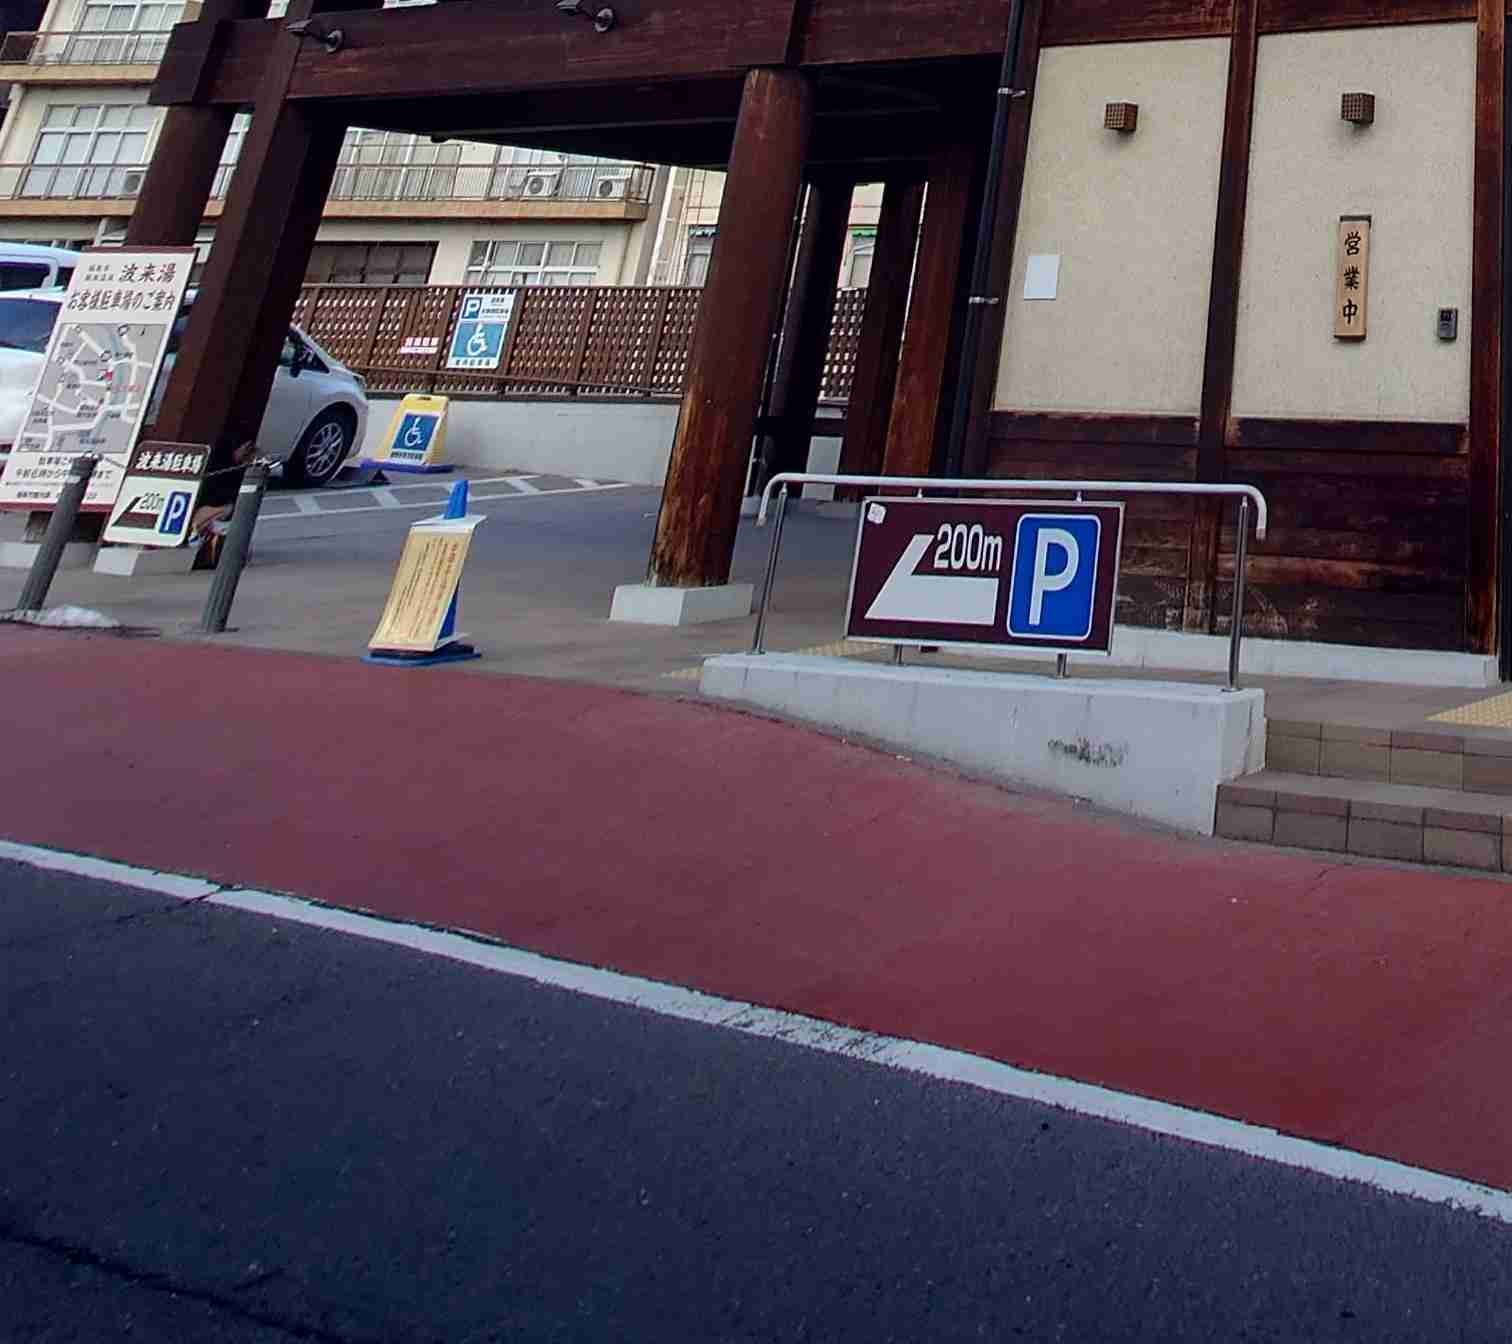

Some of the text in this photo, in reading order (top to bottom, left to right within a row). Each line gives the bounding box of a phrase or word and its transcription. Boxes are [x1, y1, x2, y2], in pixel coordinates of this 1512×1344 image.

[118, 262, 177, 283] 波来湯
[1341, 230, 1362, 326] 営業中
[164, 495, 187, 532] P
[932, 522, 1080, 627] 200m P
